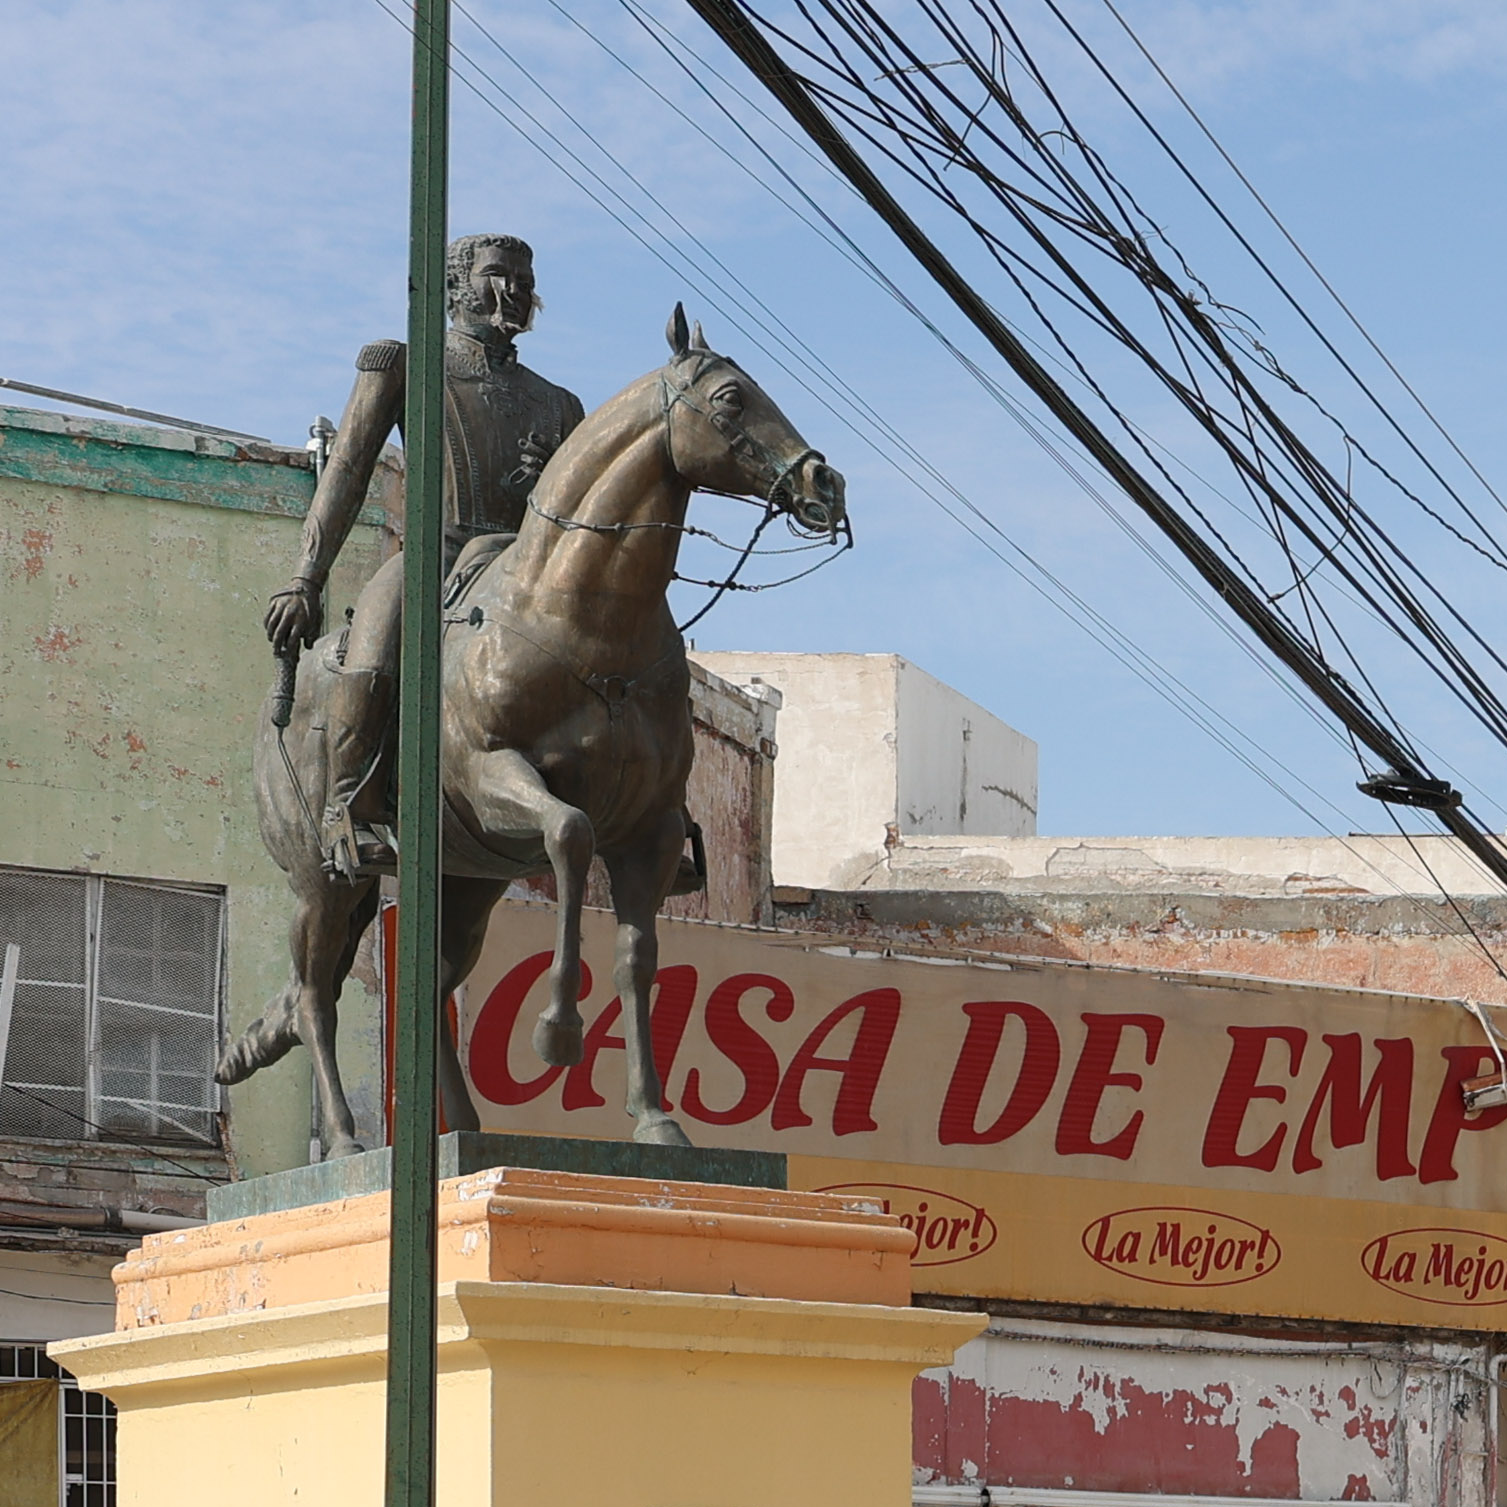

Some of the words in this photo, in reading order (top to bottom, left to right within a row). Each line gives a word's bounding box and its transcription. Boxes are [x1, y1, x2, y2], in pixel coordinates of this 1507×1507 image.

[470, 950, 902, 1136] CASA
[938, 1001, 1165, 1160] DE
[1094, 1216, 1142, 1263] La
[1149, 1222, 1270, 1281] Mejor!
[1373, 1236, 1417, 1283] La
